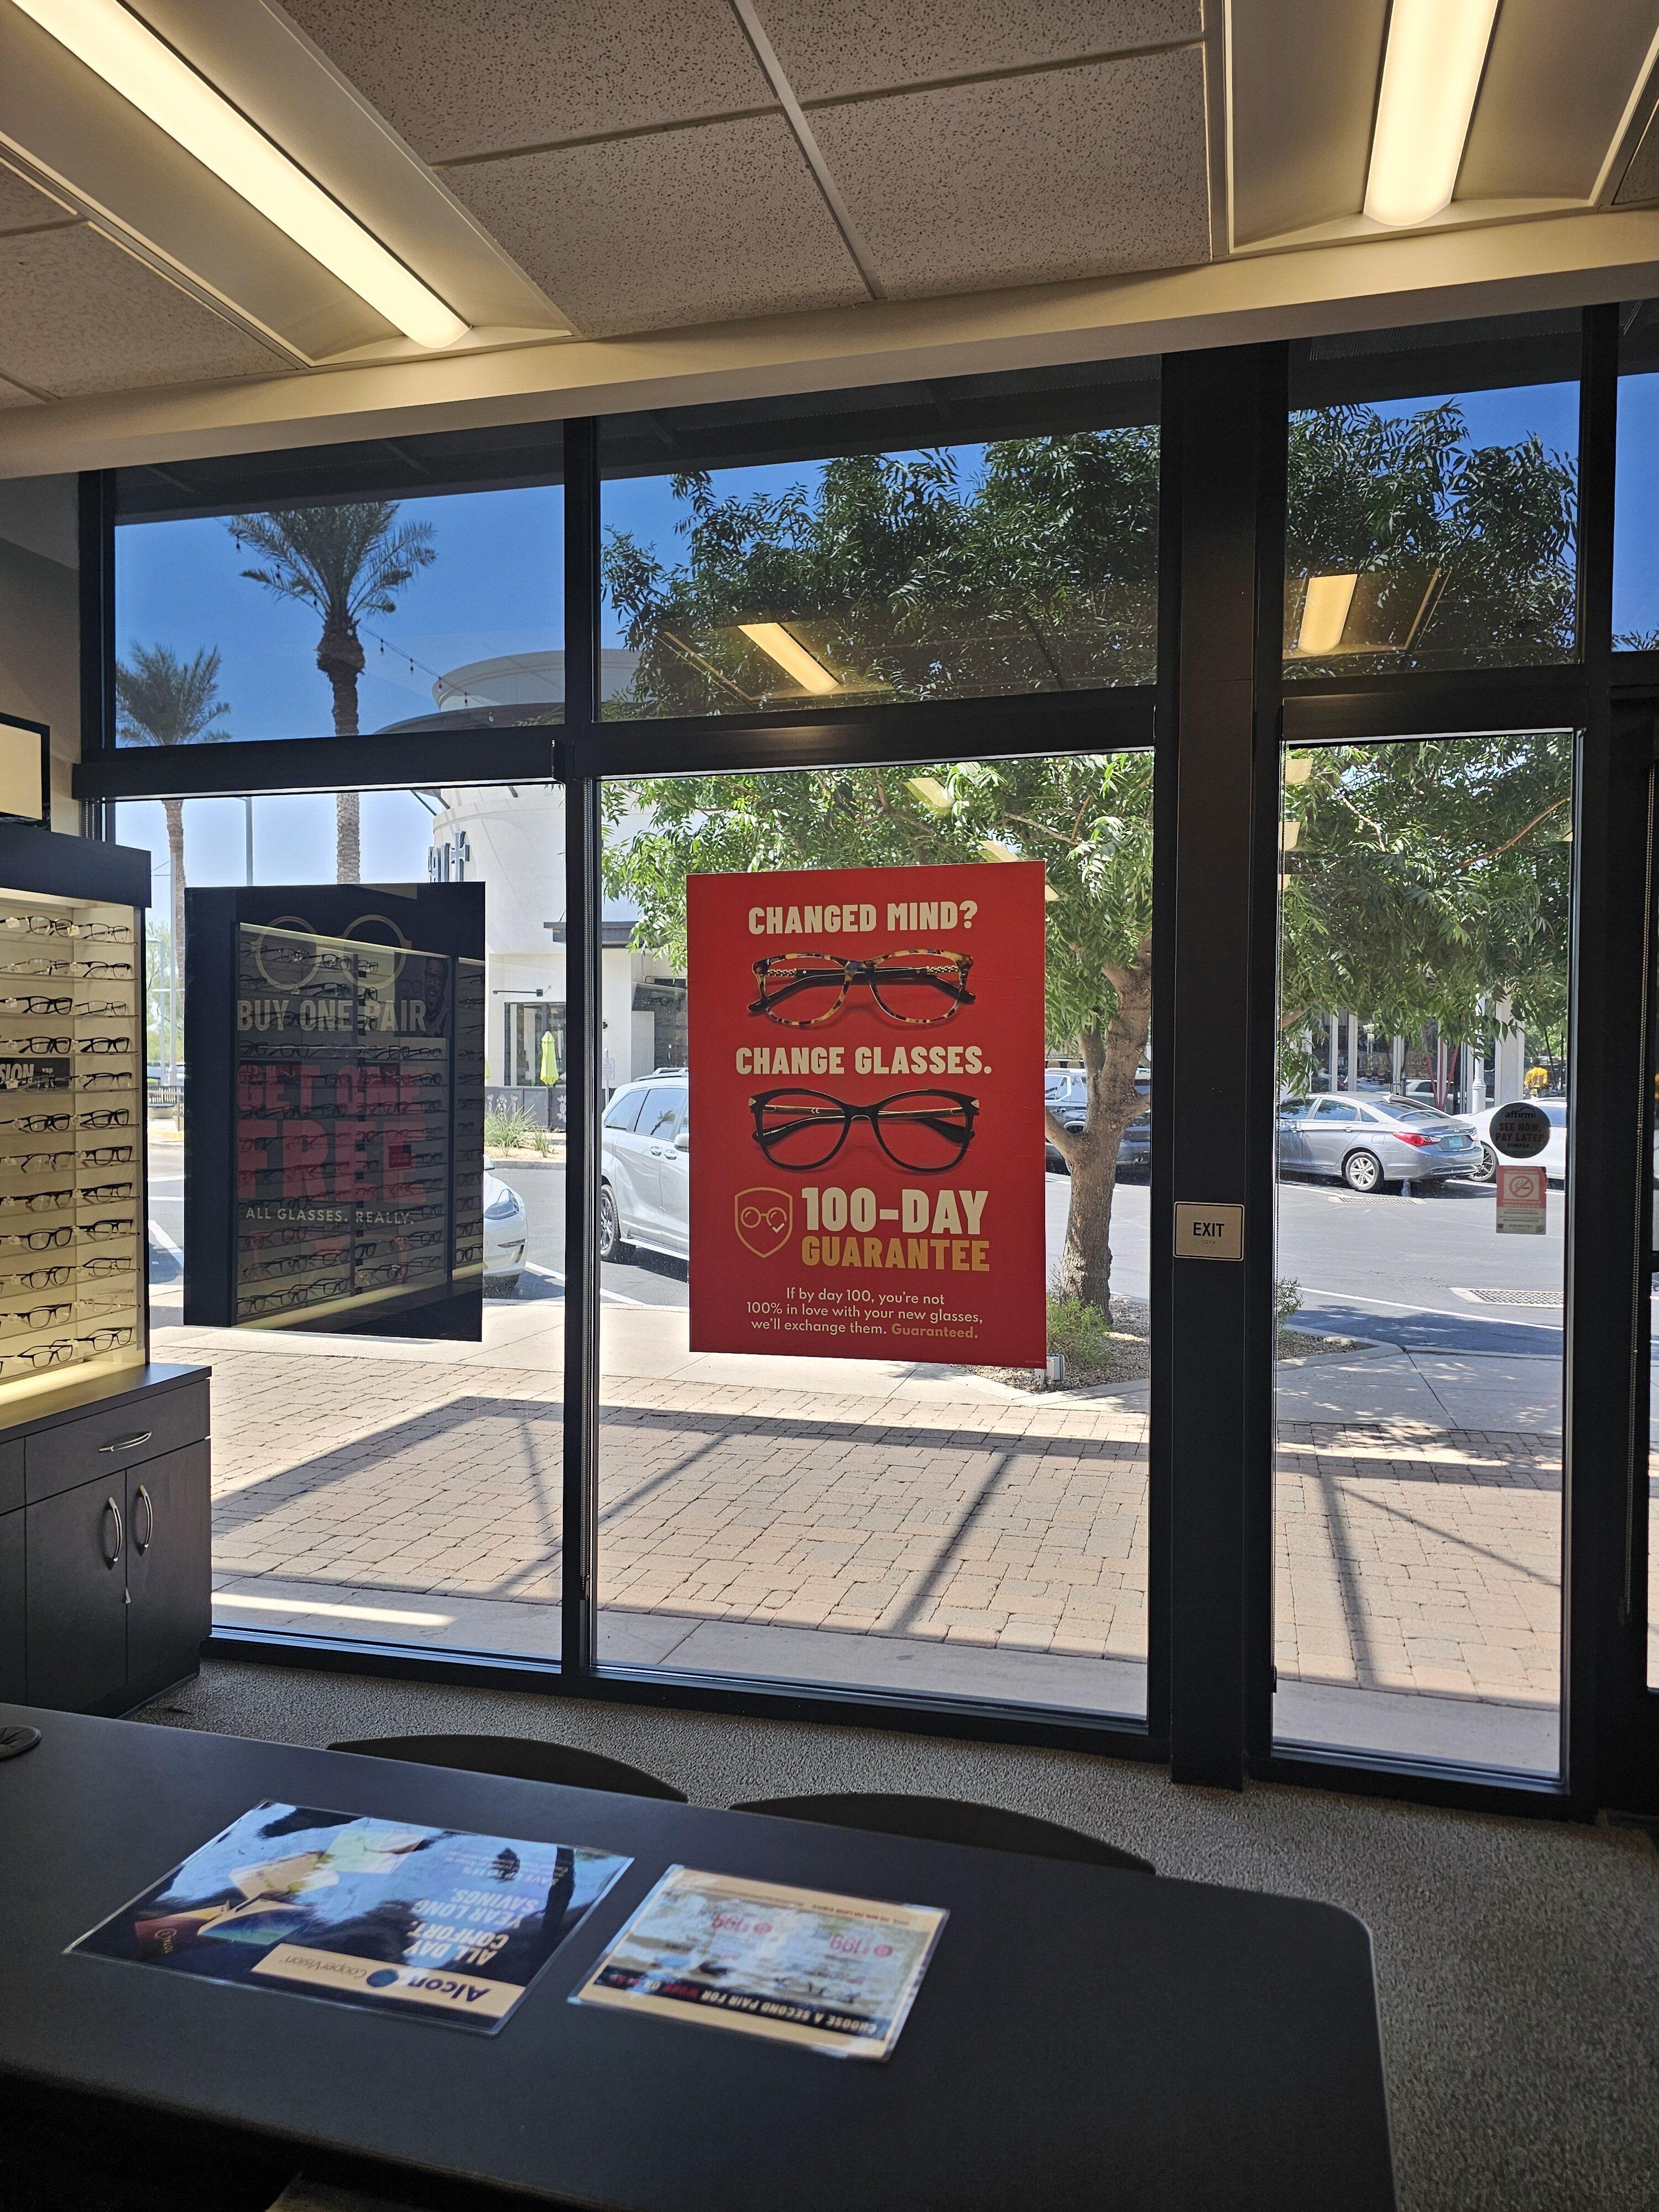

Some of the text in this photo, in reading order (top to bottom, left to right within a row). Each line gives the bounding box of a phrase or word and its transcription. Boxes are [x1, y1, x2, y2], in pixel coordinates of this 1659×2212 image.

[748, 900, 978, 935] CHANGED MIND?
[237, 999, 426, 1031] BUY ONE PAIR
[735, 1046, 992, 1075] CHANGE GLASSES.
[1505, 1108, 1535, 1119] affirm
[1495, 1133, 1512, 1141] PAY
[1499, 1123, 1541, 1133] SEE NOW,
[246, 1207, 414, 1225] ALL GLASSES. REALLY.
[802, 1187, 989, 1235] 100-DAY
[1193, 1222, 1224, 1237] EXIT
[802, 1235, 990, 1271] GUARANTEE
[786, 1287, 945, 1306] If by day 100, you're not
[747, 1301, 983, 1324] 100% in love with your new glasses,
[751, 1318, 978, 1339] we'll exchange them. Guaranteed.
[450, 1888, 540, 1913] SAVINGS.
[412, 1899, 525, 1927] YEAR LONG
[407, 1921, 509, 1948] COMFORT.
[403, 1939, 498, 1966] ALL DAY
[408, 1976, 492, 2003] Alcon
[700, 1989, 727, 2004] FOR
[728, 1995, 760, 2010] PAIR
[760, 2001, 811, 2020] SECOND
[812, 2012, 825, 2024] A
[826, 2015, 877, 2034] CHOOSE
